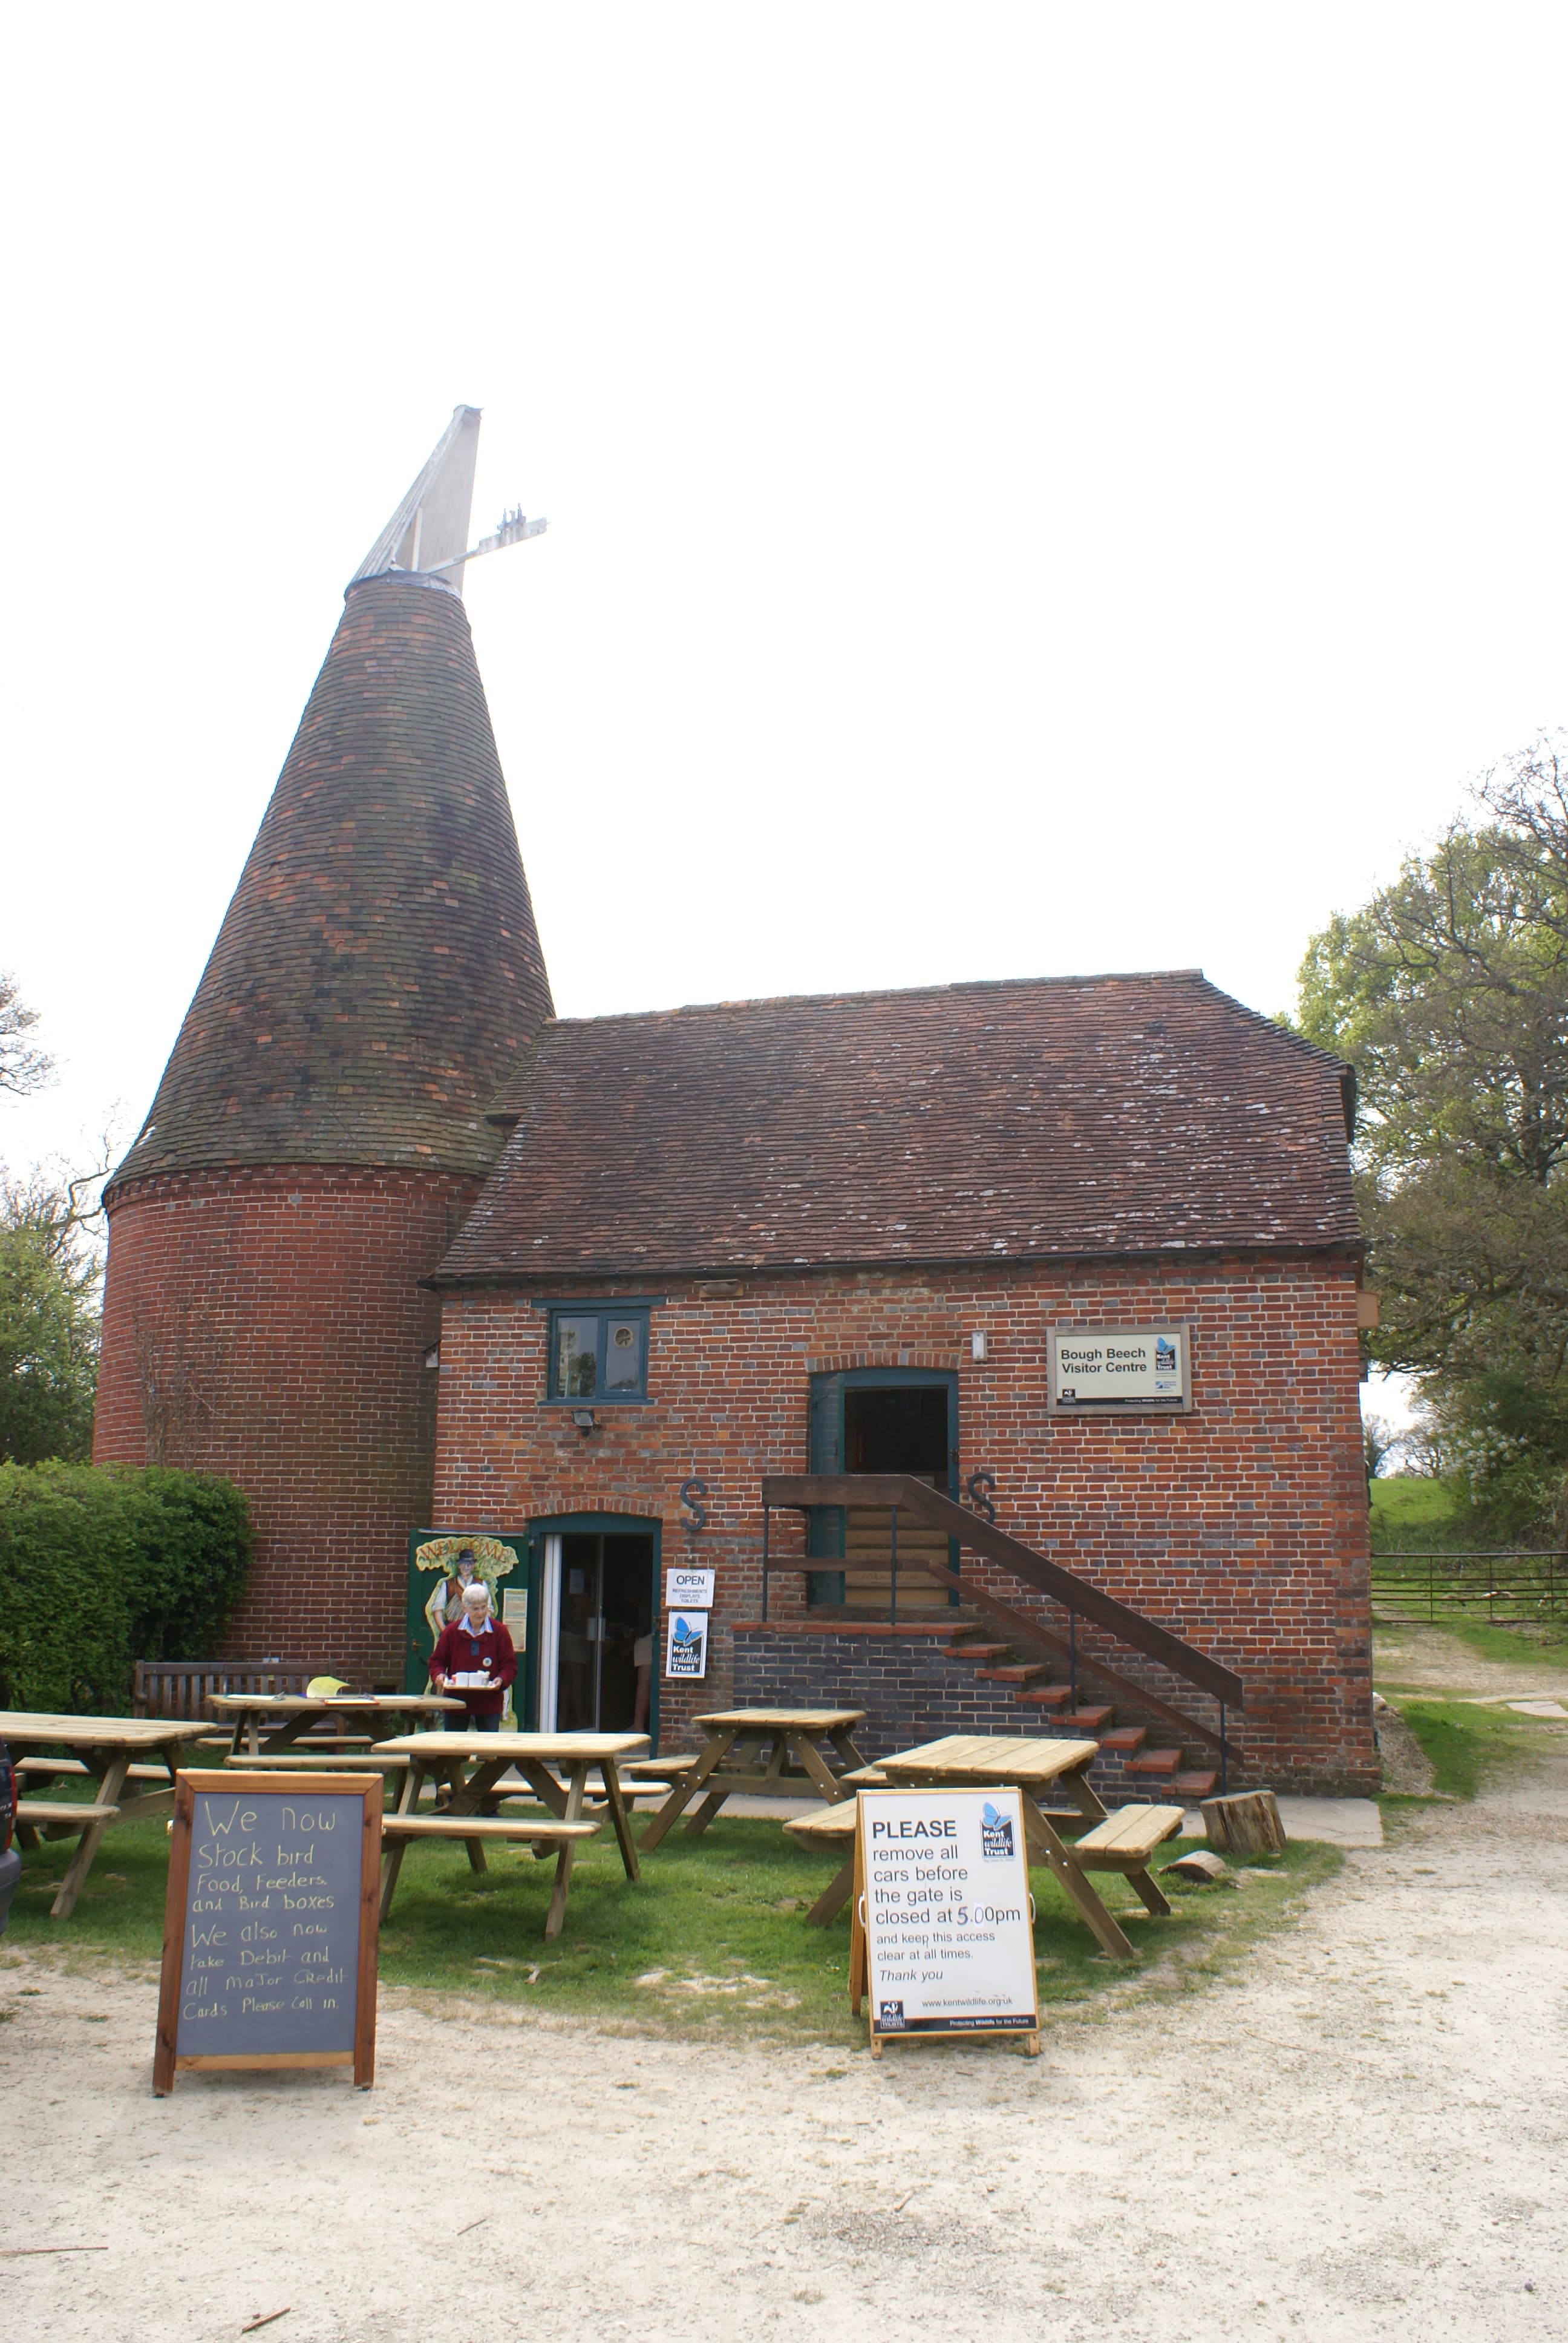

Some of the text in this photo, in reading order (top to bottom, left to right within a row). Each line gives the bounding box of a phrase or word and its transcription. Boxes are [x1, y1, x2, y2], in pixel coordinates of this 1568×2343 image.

[1061, 1348, 1146, 1362] Bough Beech
[1062, 1362, 1147, 1373] Visitor Centre
[419, 1538, 509, 1564] WELCOME
[676, 1575, 705, 1585] OPEN
[672, 1653, 700, 1664] wildlife
[205, 1800, 336, 1837] We now
[872, 1820, 957, 1838] PLEASE
[982, 1830, 1004, 1838] Kent
[984, 1838, 1012, 1848] wildlife
[198, 1841, 315, 1869] Stock bird
[873, 1844, 958, 1861] remove all
[197, 1872, 243, 1895] Food,
[874, 1866, 968, 1883] cars before
[192, 1893, 335, 1913] and Bird boxes
[875, 1886, 963, 1906] the gate is
[876, 1906, 1021, 1925] closed at 5.00pm
[192, 1921, 327, 1948] We also now
[877, 1932, 995, 1947] and keep this access
[191, 1945, 329, 1971] take Debit and
[877, 1948, 973, 1961] clear at all times.
[880, 1969, 944, 1984] Thank you
[186, 1976, 208, 1997] all
[183, 2002, 227, 2020] Cards
[242, 1997, 284, 2013] Please
